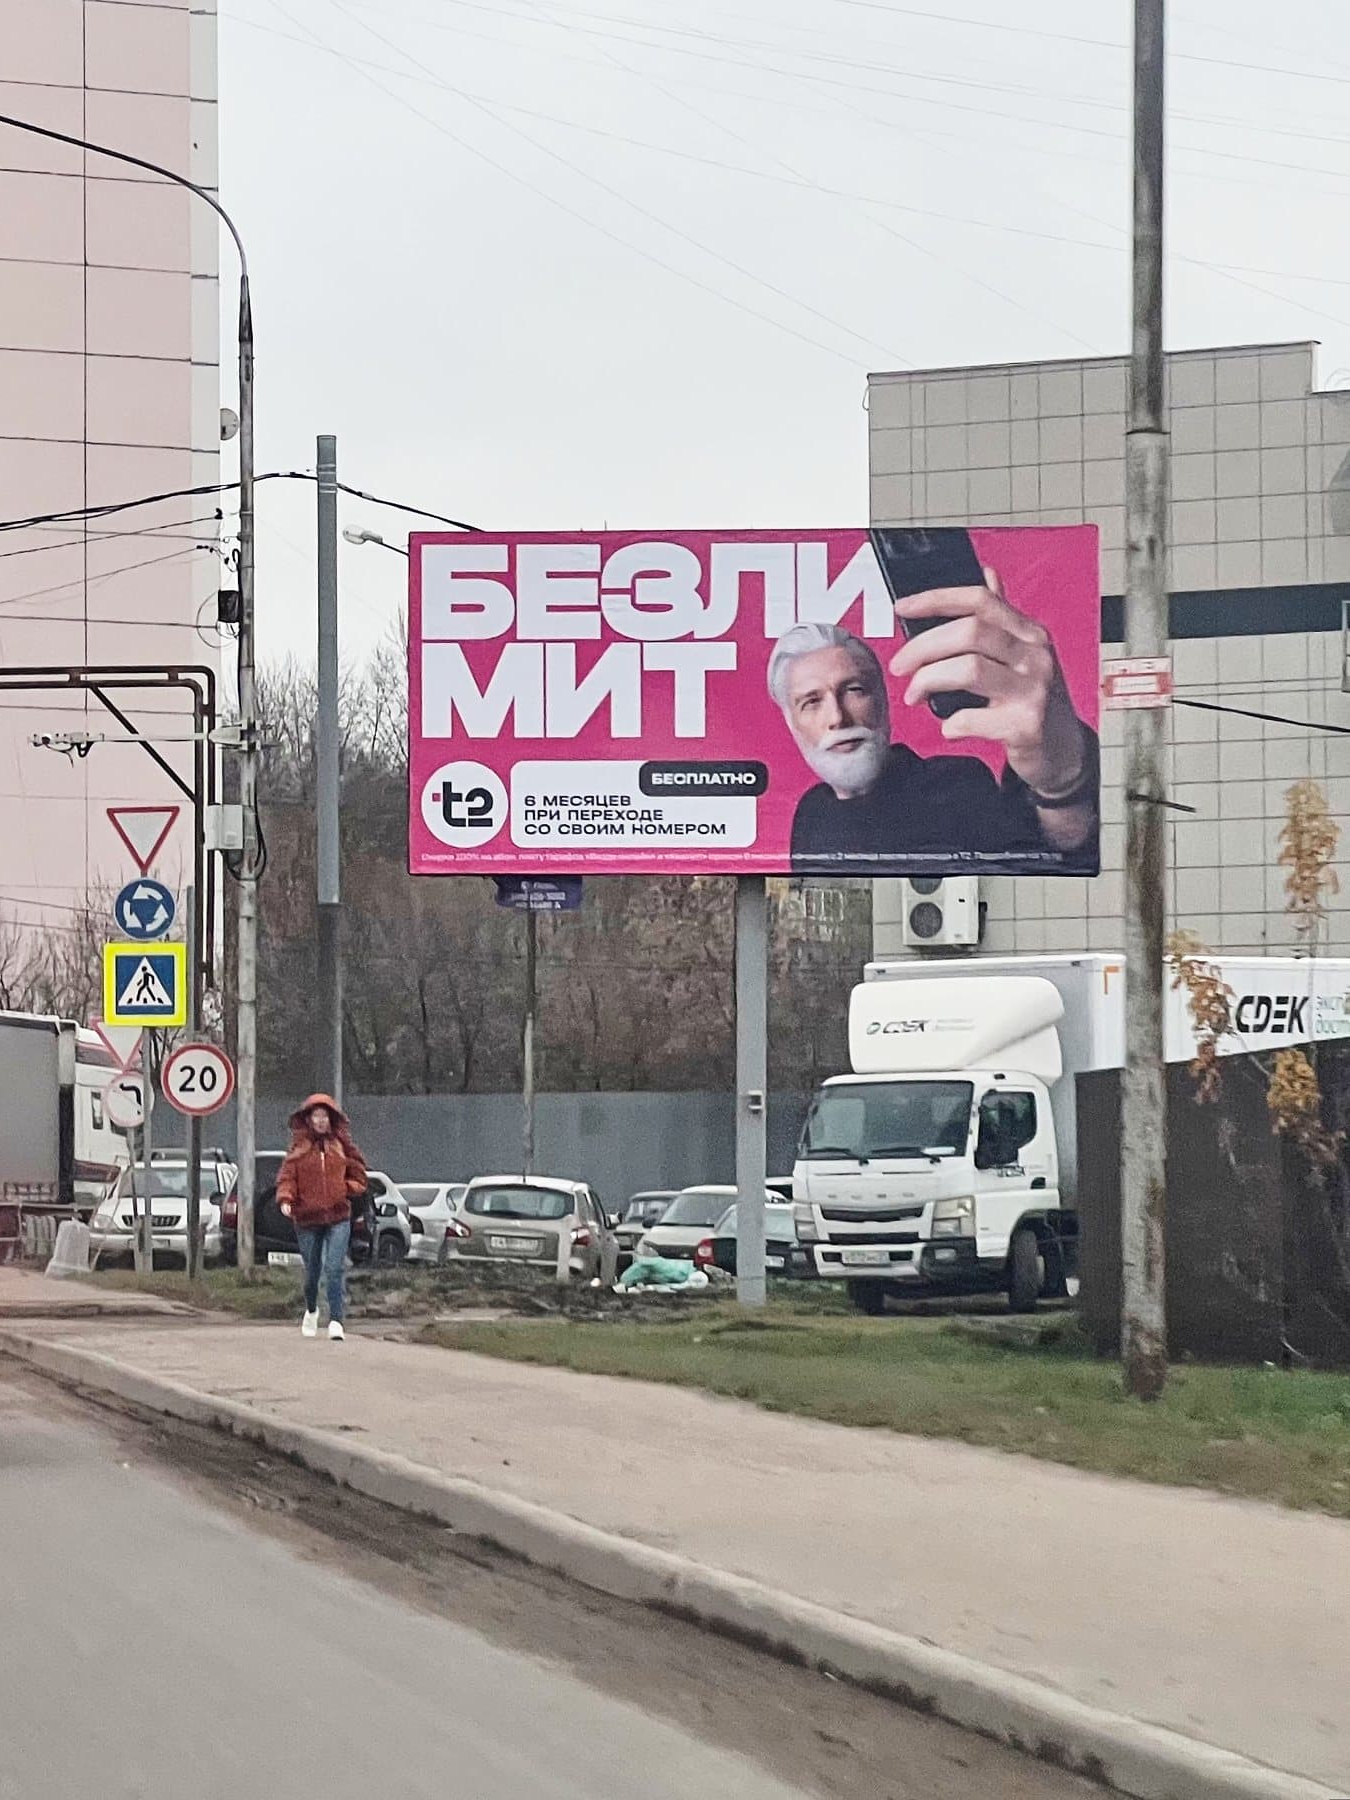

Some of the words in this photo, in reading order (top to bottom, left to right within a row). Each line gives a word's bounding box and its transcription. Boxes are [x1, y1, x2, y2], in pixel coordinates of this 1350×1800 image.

[421, 541, 895, 641] БЕЗЛИ
[421, 642, 738, 739] МИТ
[651, 772, 757, 786] БЕСПЛАТНО
[440, 781, 494, 828] t2
[524, 795, 536, 807] 6
[542, 795, 632, 808] МЕСЯЦЕВ
[524, 809, 561, 821] ПРИ
[567, 809, 664, 822] ПЕРЕХОДЕ
[524, 823, 552, 835] СО
[557, 823, 626, 836] СВОИМ
[631, 823, 727, 836] НОМЕРОМ
[1235, 995, 1310, 1033] CDEK
[178, 1065, 217, 1092] 20
